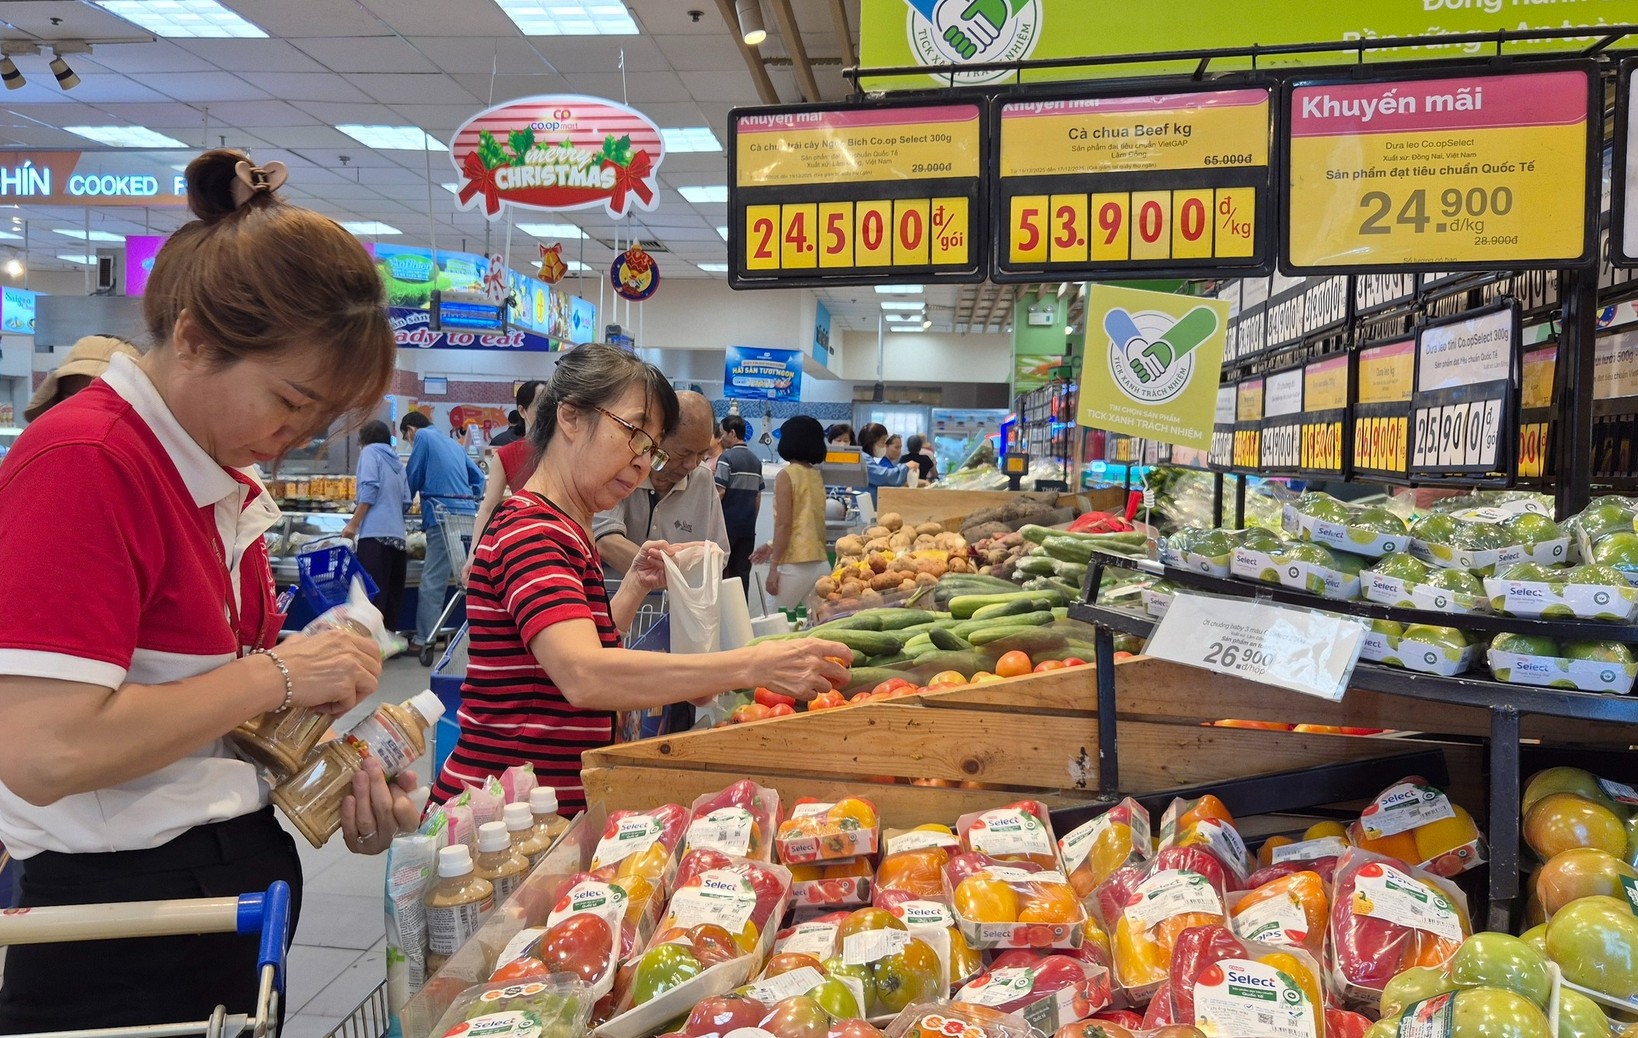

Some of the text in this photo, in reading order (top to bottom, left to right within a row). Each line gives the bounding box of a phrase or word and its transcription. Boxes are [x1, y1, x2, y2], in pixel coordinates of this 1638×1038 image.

[917, 28, 934, 57] TICK
[1302, 86, 1483, 122] Khuyến mãi
[1068, 123, 1192, 140] Cà chua Beef kg
[750, 142, 762, 152] Cà
[804, 141, 820, 151] cây
[848, 138, 868, 147] Bích
[870, 136, 896, 146] Co.op
[900, 135, 928, 145] Select
[930, 134, 952, 144] 300g
[1157, 139, 1188, 149] VietGAP
[1405, 140, 1420, 149] leo
[1421, 138, 1474, 149] Co.opSelect
[526, 147, 592, 171] merry
[1204, 154, 1253, 166] 65.000đ
[1460, 151, 1477, 159] Nam
[495, 165, 617, 191] CHRISTMAS
[1326, 161, 1535, 182] Sản phẩm đạt tiêu chuẩn Quốc Tế
[69, 175, 159, 197] COOKED
[1358, 186, 1513, 236] 24.900
[1017, 197, 1205, 252] 53.900
[1450, 217, 1485, 234] đ/kg
[753, 208, 923, 259] 24.500
[447, 330, 526, 347] to eat
[1494, 328, 1509, 342] 300g
[1113, 356, 1187, 397] TICK XANH TRÁCH NHIỆM
[1087, 409, 1203, 440] TICK XANH TRÁCH NHIỆM
[1417, 409, 1480, 454] 25.900
[1356, 423, 1396, 457] 26.900
[1317, 527, 1344, 539] Select
[1236, 555, 1257, 566] Select
[1499, 552, 1520, 562] Select
[1324, 578, 1340, 588] Select
[1373, 580, 1398, 592] Select
[1510, 587, 1543, 597] Select
[1150, 597, 1167, 606] Selec
[1230, 624, 1246, 634] baby
[1516, 661, 1549, 672] Select
[1382, 789, 1417, 805] Select
[621, 822, 648, 831] Select
[988, 816, 1019, 828] Select
[791, 844, 815, 853] Select
[1224, 825, 1244, 857] Select
[704, 880, 736, 891] Select
[907, 907, 942, 916] Select
[983, 929, 1011, 938] Select
[1228, 971, 1276, 988] Select
